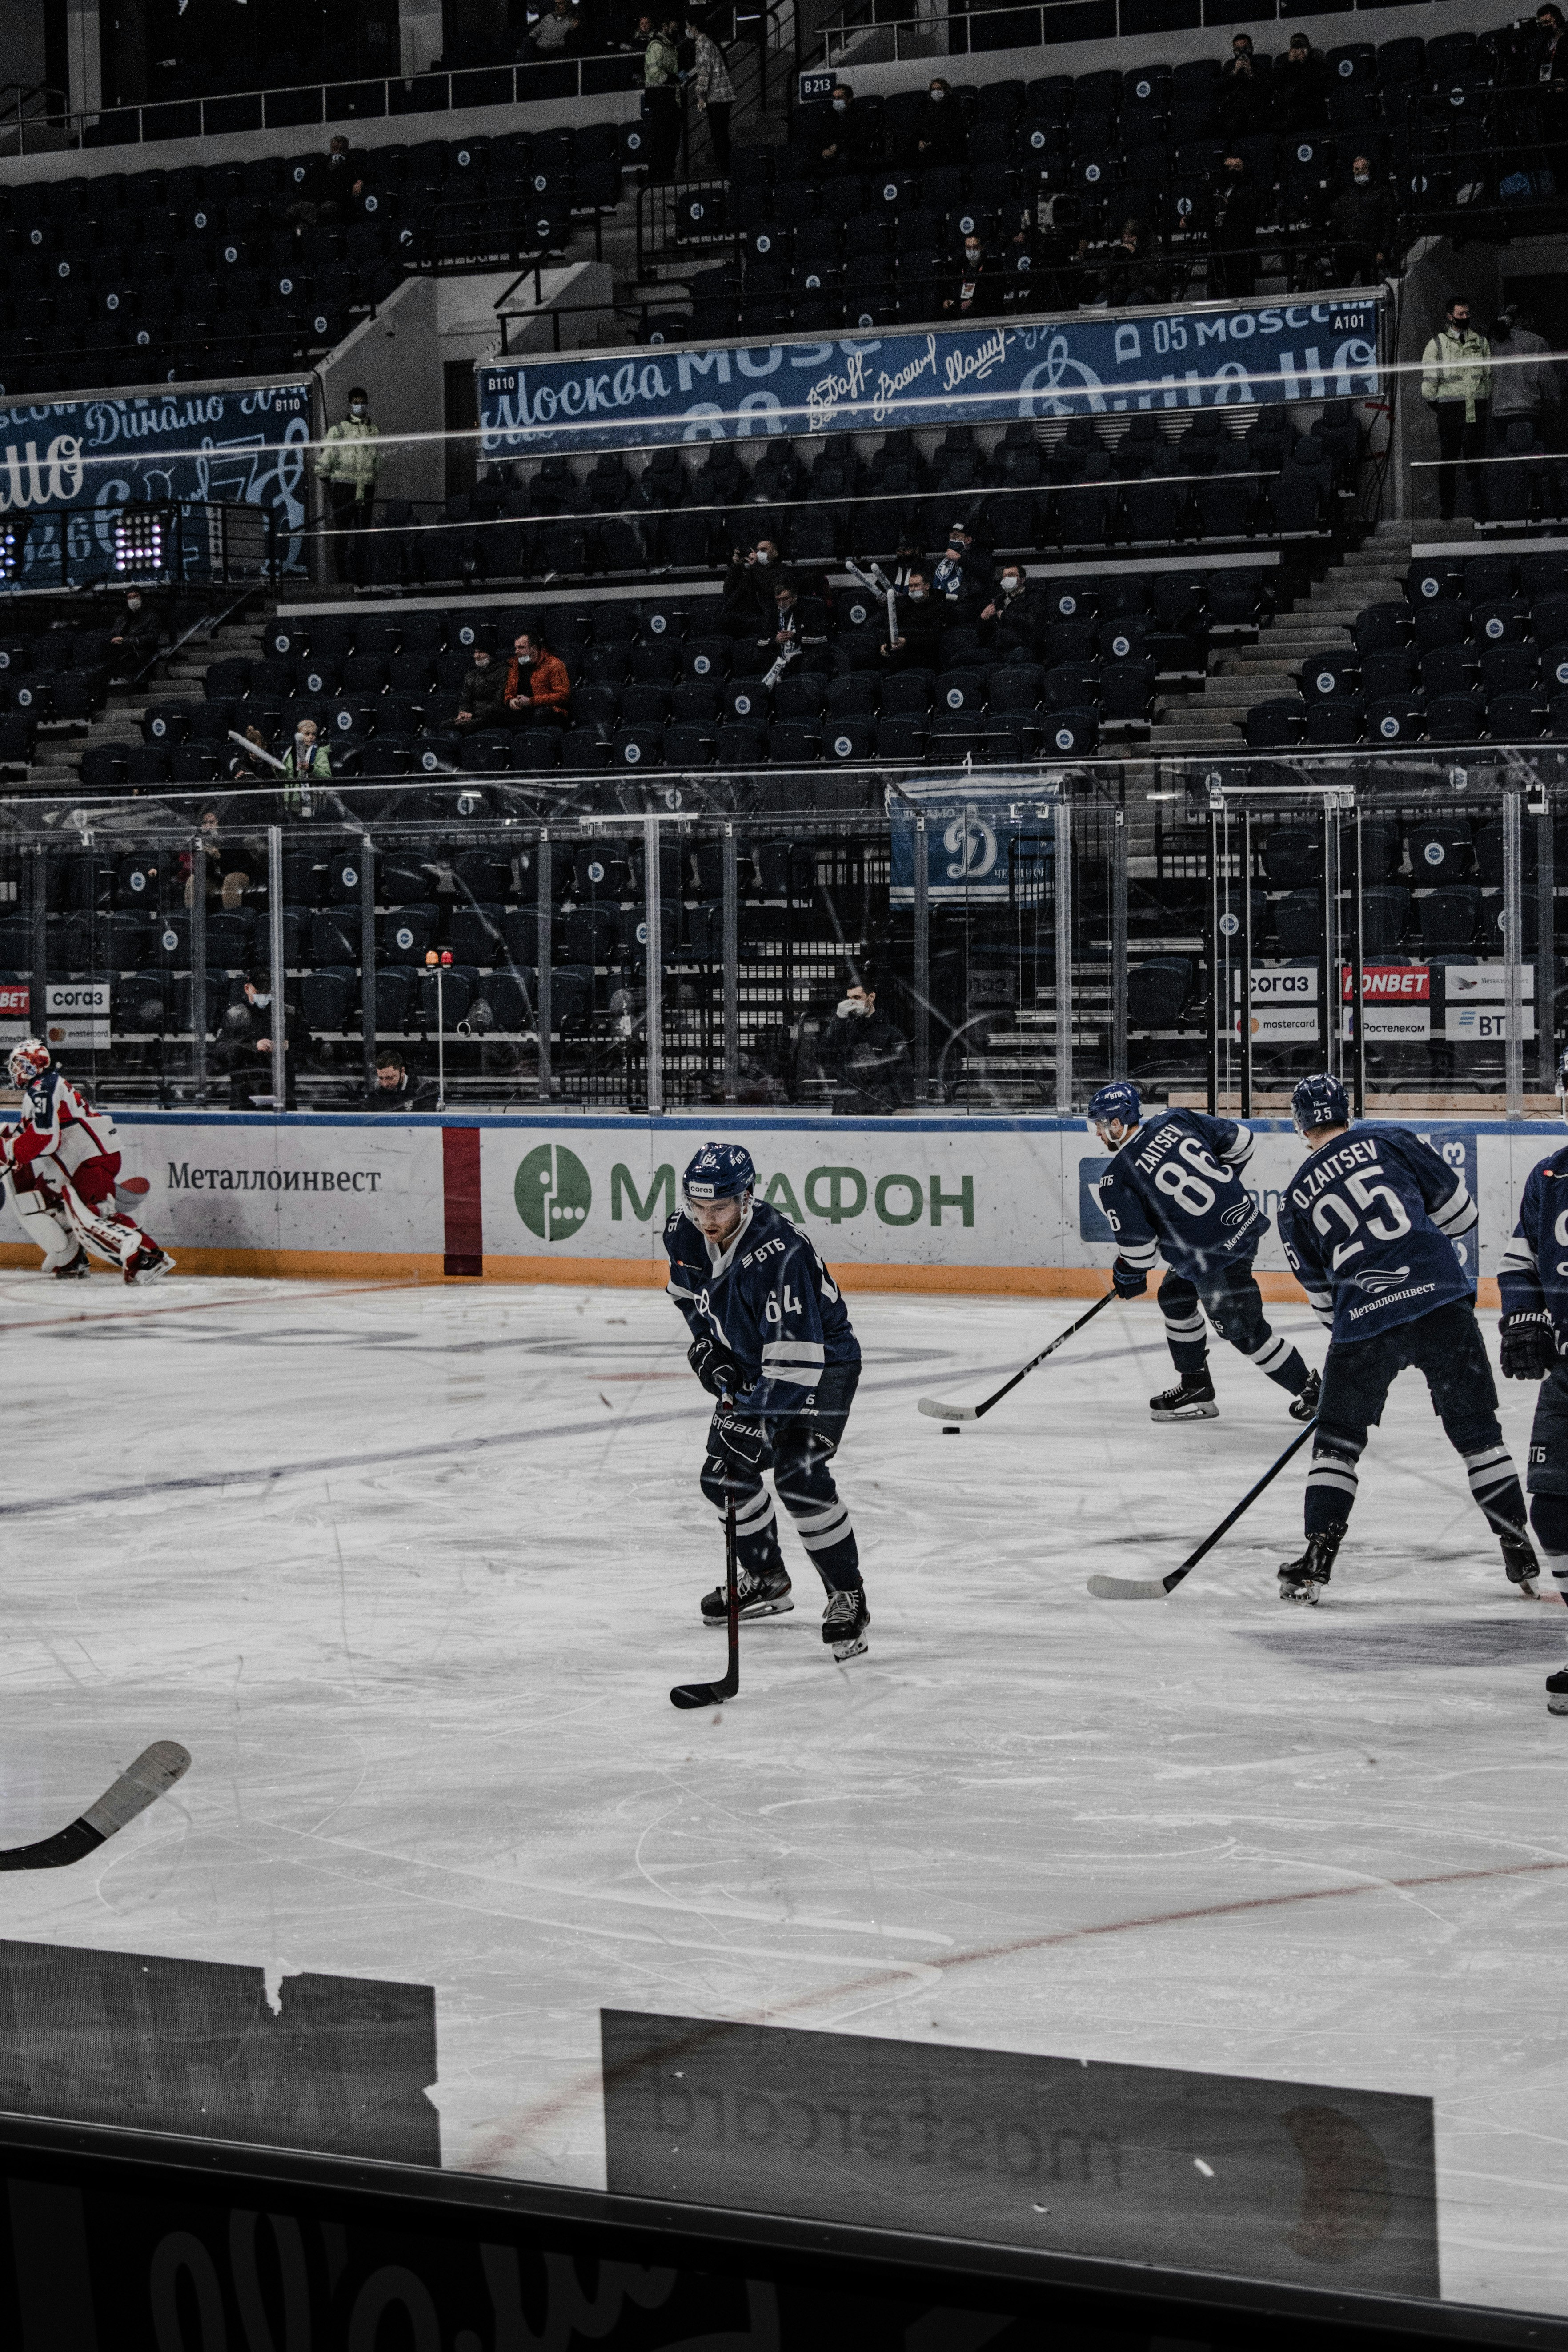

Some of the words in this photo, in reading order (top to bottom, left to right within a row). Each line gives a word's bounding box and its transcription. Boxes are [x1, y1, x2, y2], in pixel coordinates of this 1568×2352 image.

[805, 79, 830, 93] B213
[1334, 314, 1365, 329] A101
[1153, 317, 1187, 354] 05
[488, 376, 515, 391] B110
[275, 398, 301, 412] B110
[1263, 1019, 1315, 1029] mastercard
[1363, 1023, 1425, 1033] Ростелеком
[1479, 1016, 1506, 1036] ВТ
[1313, 1107, 1332, 1122] 25
[1135, 1123, 1183, 1174] ZAITSEV
[168, 1162, 381, 1193] Металлоинвест
[1155, 1137, 1234, 1216] 86
[1292, 1139, 1378, 1209] O.ZAITSEV
[611, 1162, 974, 1227] МАФОН
[690, 1186, 713, 1194] согаз
[1107, 1208, 1122, 1232] 6
[1312, 1165, 1411, 1272] 25
[754, 1238, 786, 1263] ВТБ
[1283, 1242, 1300, 1270] 5
[765, 1284, 802, 1324] 64
[1349, 1282, 1436, 1321] Металлоинвест
[1529, 1446, 1546, 1463] ТБ
